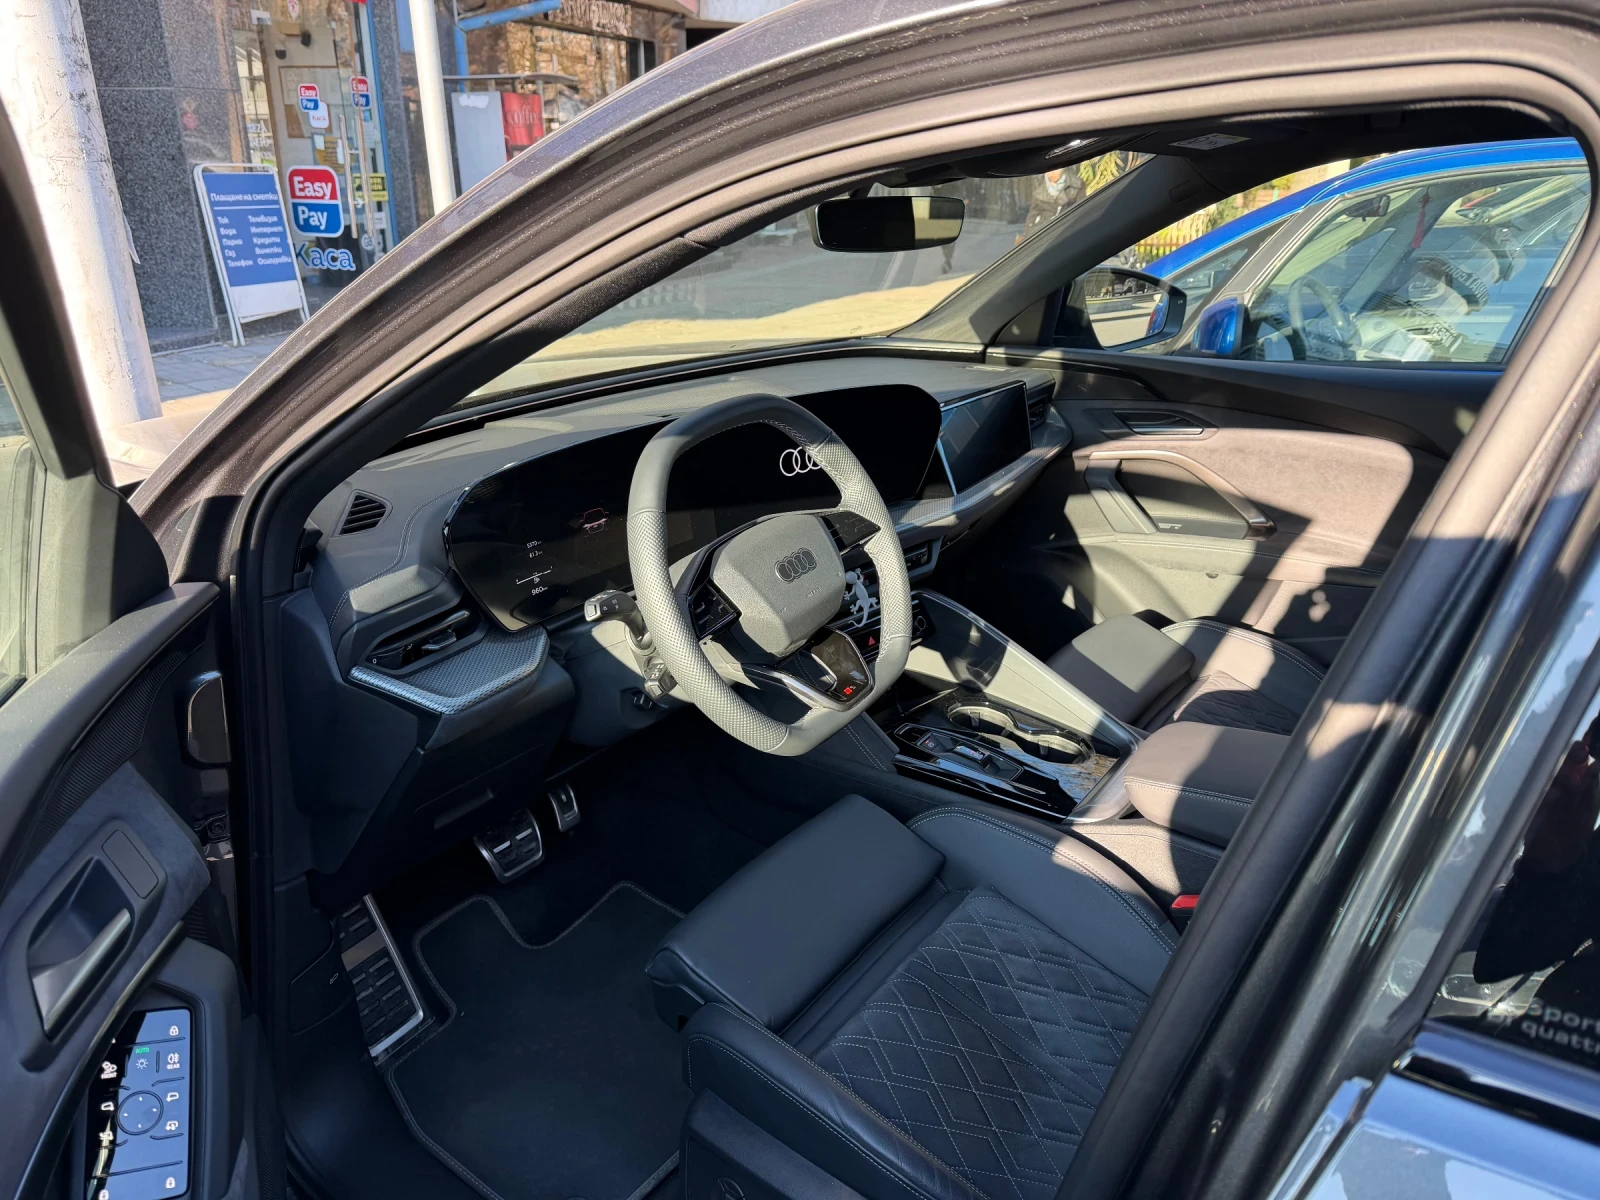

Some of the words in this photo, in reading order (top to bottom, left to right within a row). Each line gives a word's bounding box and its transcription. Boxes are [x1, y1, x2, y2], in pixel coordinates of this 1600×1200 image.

[301, 87, 317, 97] Easy
[302, 99, 315, 109] Pay
[293, 176, 332, 200] Easy
[298, 205, 327, 230] Pay
[220, 228, 237, 236] Вода
[531, 586, 544, 596] 960
